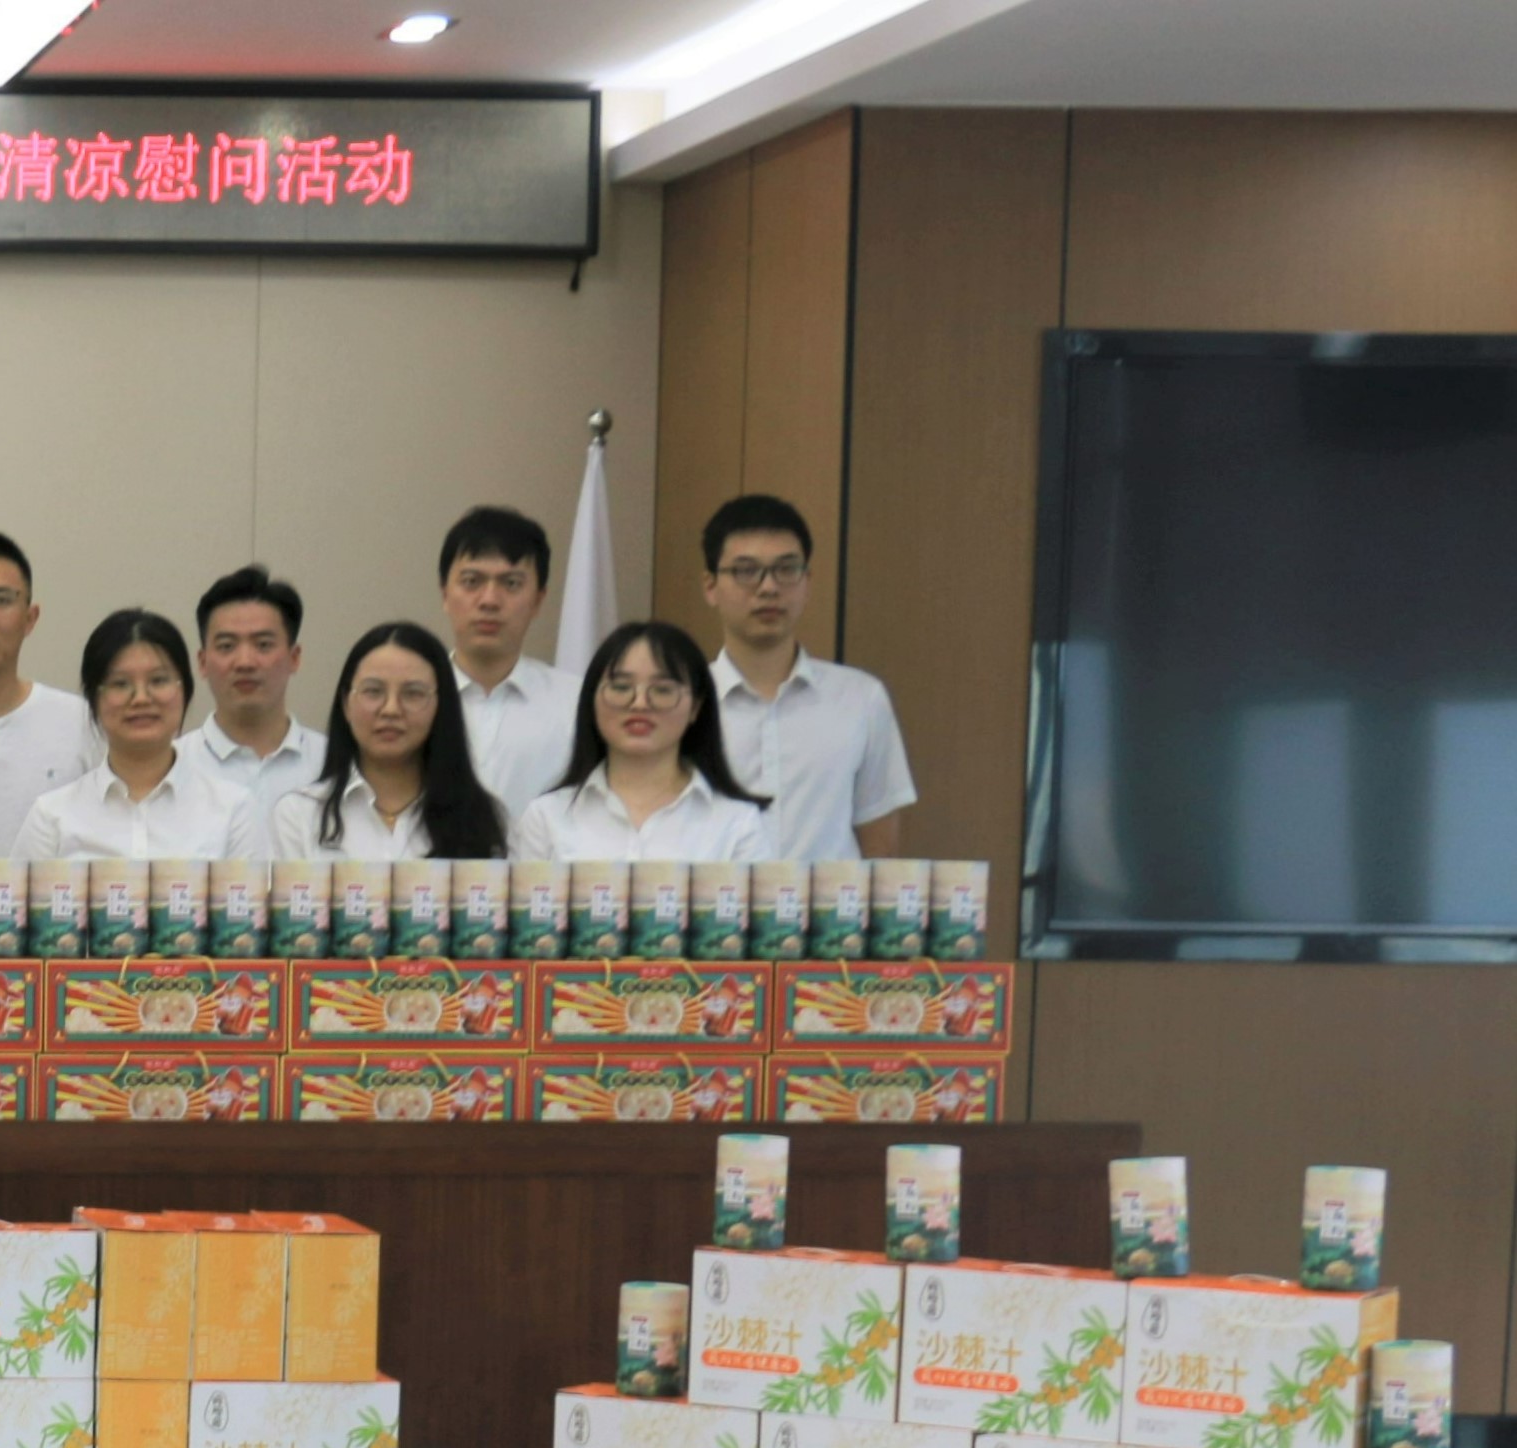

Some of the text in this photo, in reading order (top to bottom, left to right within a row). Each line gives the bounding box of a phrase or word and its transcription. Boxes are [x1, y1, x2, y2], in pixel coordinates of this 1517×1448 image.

[702, 1317, 800, 1356] 沙棘汁
[914, 1333, 1019, 1373] 沙棘汁
[1137, 1352, 1245, 1394] 沙棘汁
